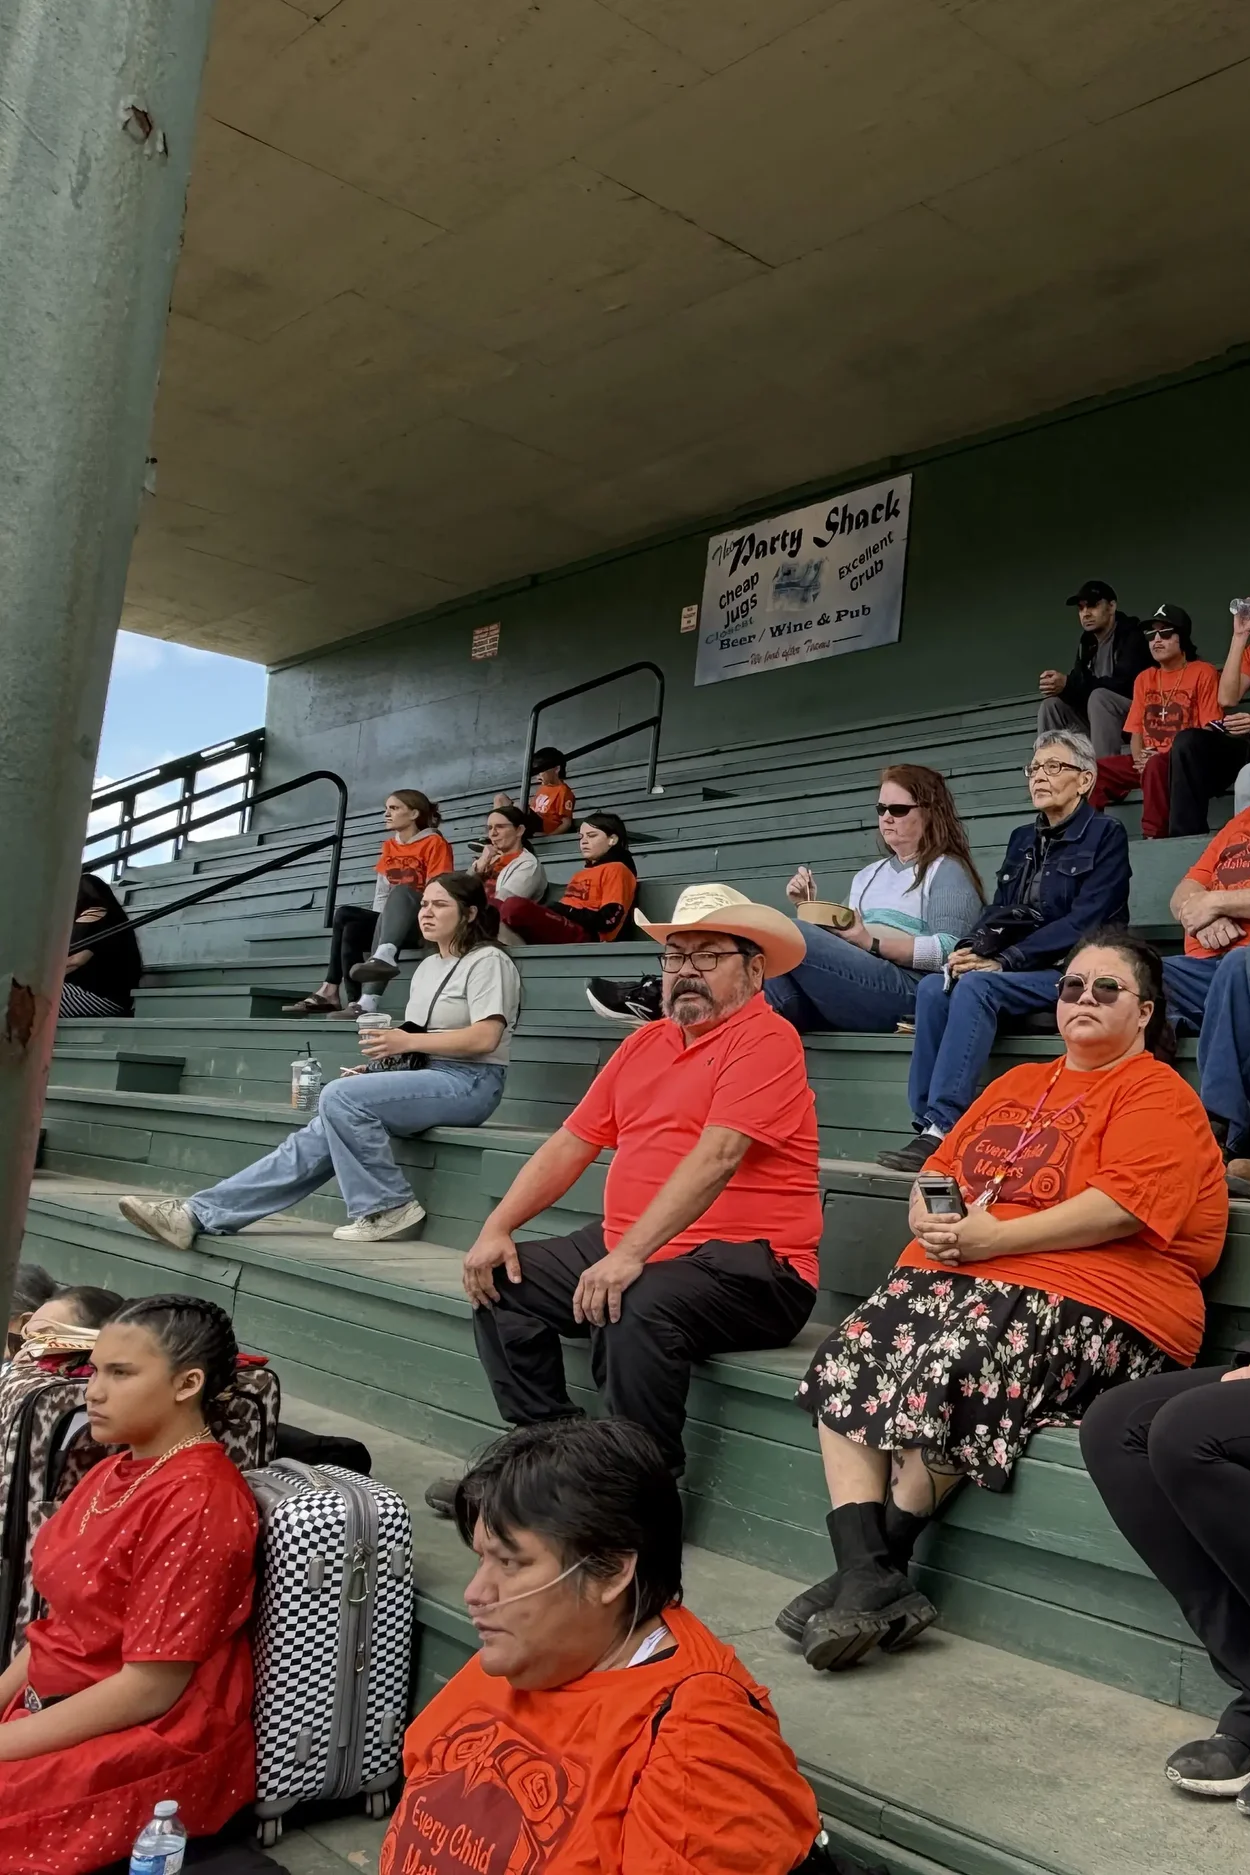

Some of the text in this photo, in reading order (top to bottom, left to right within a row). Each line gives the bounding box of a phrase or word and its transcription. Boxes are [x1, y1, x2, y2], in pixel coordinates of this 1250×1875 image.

[728, 527, 803, 578] Party
[813, 489, 900, 548] Shack
[838, 530, 894, 580] Excellent
[849, 558, 884, 591] Grub
[719, 633, 757, 651] Beer
[770, 620, 813, 638] Wine
[816, 612, 831, 626] &
[834, 604, 871, 623] Pub
[973, 1159, 1024, 1178] Maers
[1017, 1144, 1048, 1161] hild
[412, 1796, 496, 1874] Every Child
